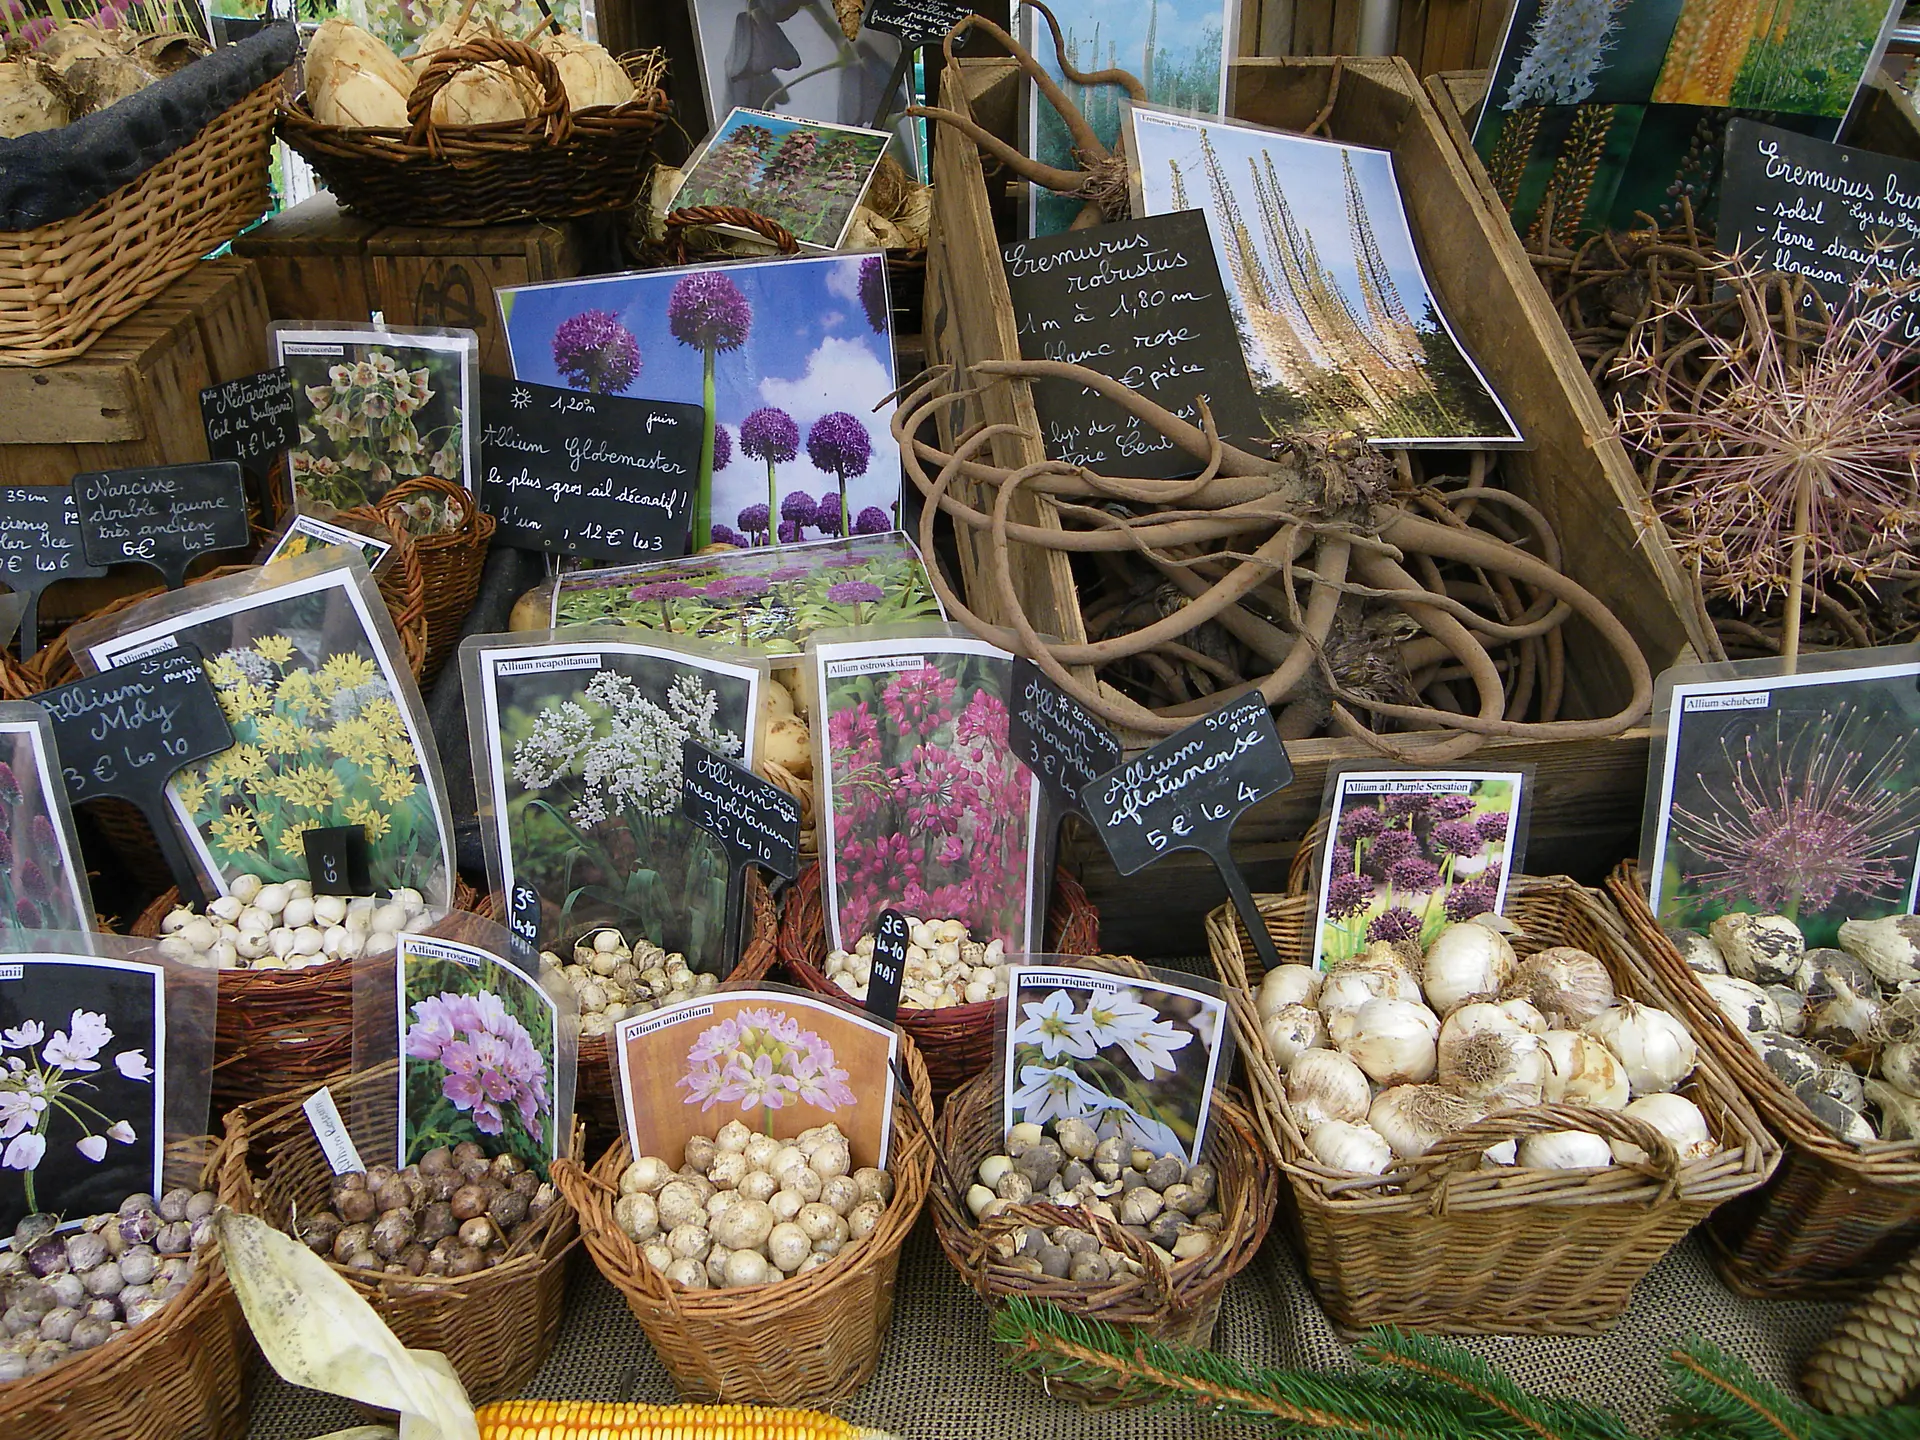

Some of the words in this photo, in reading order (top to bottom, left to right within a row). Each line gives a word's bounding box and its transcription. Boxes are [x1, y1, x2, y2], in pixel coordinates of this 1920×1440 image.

[871, 10, 923, 31] fritillaire
[904, 11, 954, 29] persica
[1758, 140, 1874, 201] Eremurus
[1773, 197, 1825, 225] soleil
[1772, 220, 1816, 251] terre
[1003, 233, 1150, 277] Eremurus
[1772, 248, 1847, 284] floraison
[1067, 248, 1189, 293] robustus
[1073, 303, 1095, 323] à
[287, 345, 342, 354] Nectaroscordum
[1044, 340, 1115, 363] blanc
[1133, 326, 1200, 346] rose
[1149, 357, 1205, 391] pièce
[236, 418, 249, 430] de
[645, 411, 678, 434] juin
[1088, 420, 1117, 437] des
[480, 424, 551, 454] Allium
[564, 437, 688, 476] Globemaster
[486, 467, 503, 484] le
[506, 468, 541, 493] plus
[545, 479, 582, 502] gros
[587, 478, 612, 497] ail
[89, 498, 159, 523] double
[168, 495, 231, 525] jaune
[100, 523, 130, 539] très
[137, 518, 215, 537] ancien
[632, 532, 649, 550] les
[650, 537, 663, 551] 3
[182, 535, 201, 551] les
[203, 533, 216, 547] 5
[60, 552, 71, 569] 6
[499, 660, 533, 672] Allium
[535, 656, 599, 670] neapolitanum
[830, 663, 858, 674] Allium
[860, 657, 921, 671] ostrowskianum
[40, 682, 155, 722] Allium
[1687, 699, 1719, 709] Allium
[1720, 695, 1766, 707] schubertii
[90, 698, 182, 740] Moly
[1025, 679, 1094, 753] Allium
[1229, 707, 1266, 733] giugno
[162, 737, 188, 756] 10
[697, 754, 772, 810] Allium
[1103, 740, 1204, 804] Allium
[1346, 782, 1377, 792] Allium
[1396, 782, 1424, 793] Purple
[1426, 782, 1468, 791] Sensation
[686, 779, 794, 849] neapolitanum
[1200, 803, 1231, 821] le
[1237, 781, 1260, 802] 4
[758, 840, 771, 860] 10
[409, 944, 444, 957] Allium
[446, 951, 480, 965] roseum
[1023, 976, 1059, 984] Allium
[1061, 977, 1115, 991] triquetrum
[627, 1021, 661, 1039] Allium
[663, 1006, 711, 1025] unifolium
